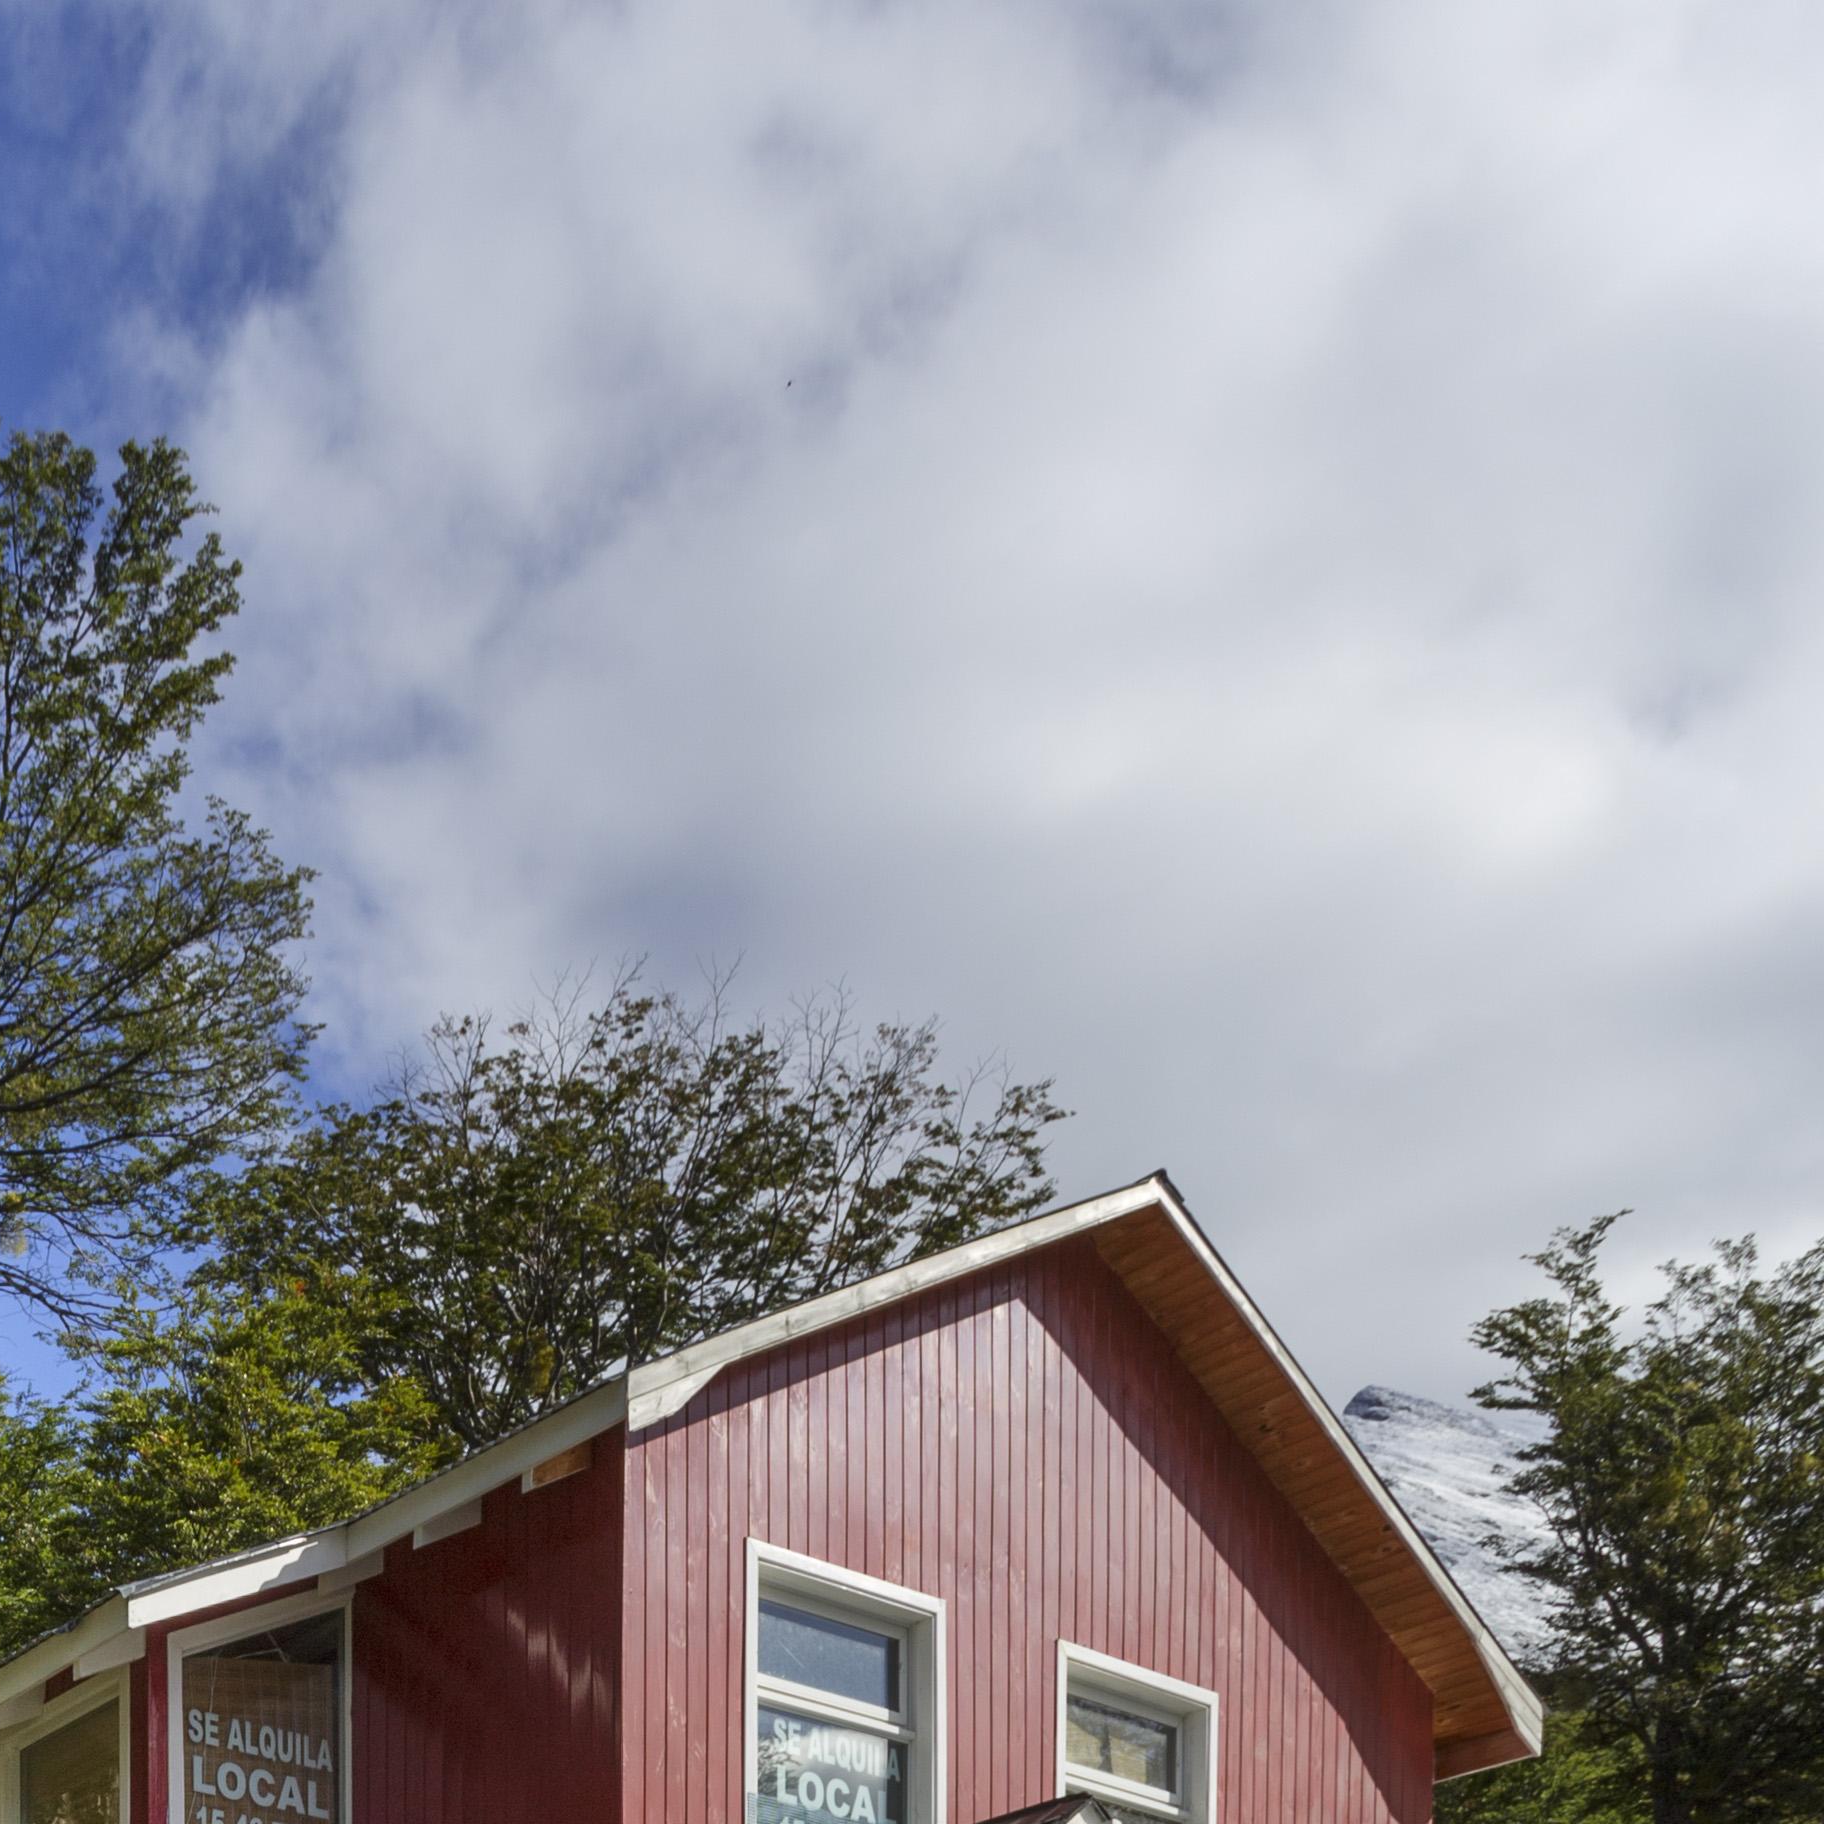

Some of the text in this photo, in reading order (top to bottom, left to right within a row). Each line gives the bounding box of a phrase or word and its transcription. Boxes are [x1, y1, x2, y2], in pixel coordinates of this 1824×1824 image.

[188, 1708, 333, 1772] SE ALQUILA
[773, 1718, 801, 1755] SE
[192, 1755, 329, 1819] LOCAL
[776, 1764, 896, 1824] LOCAL
